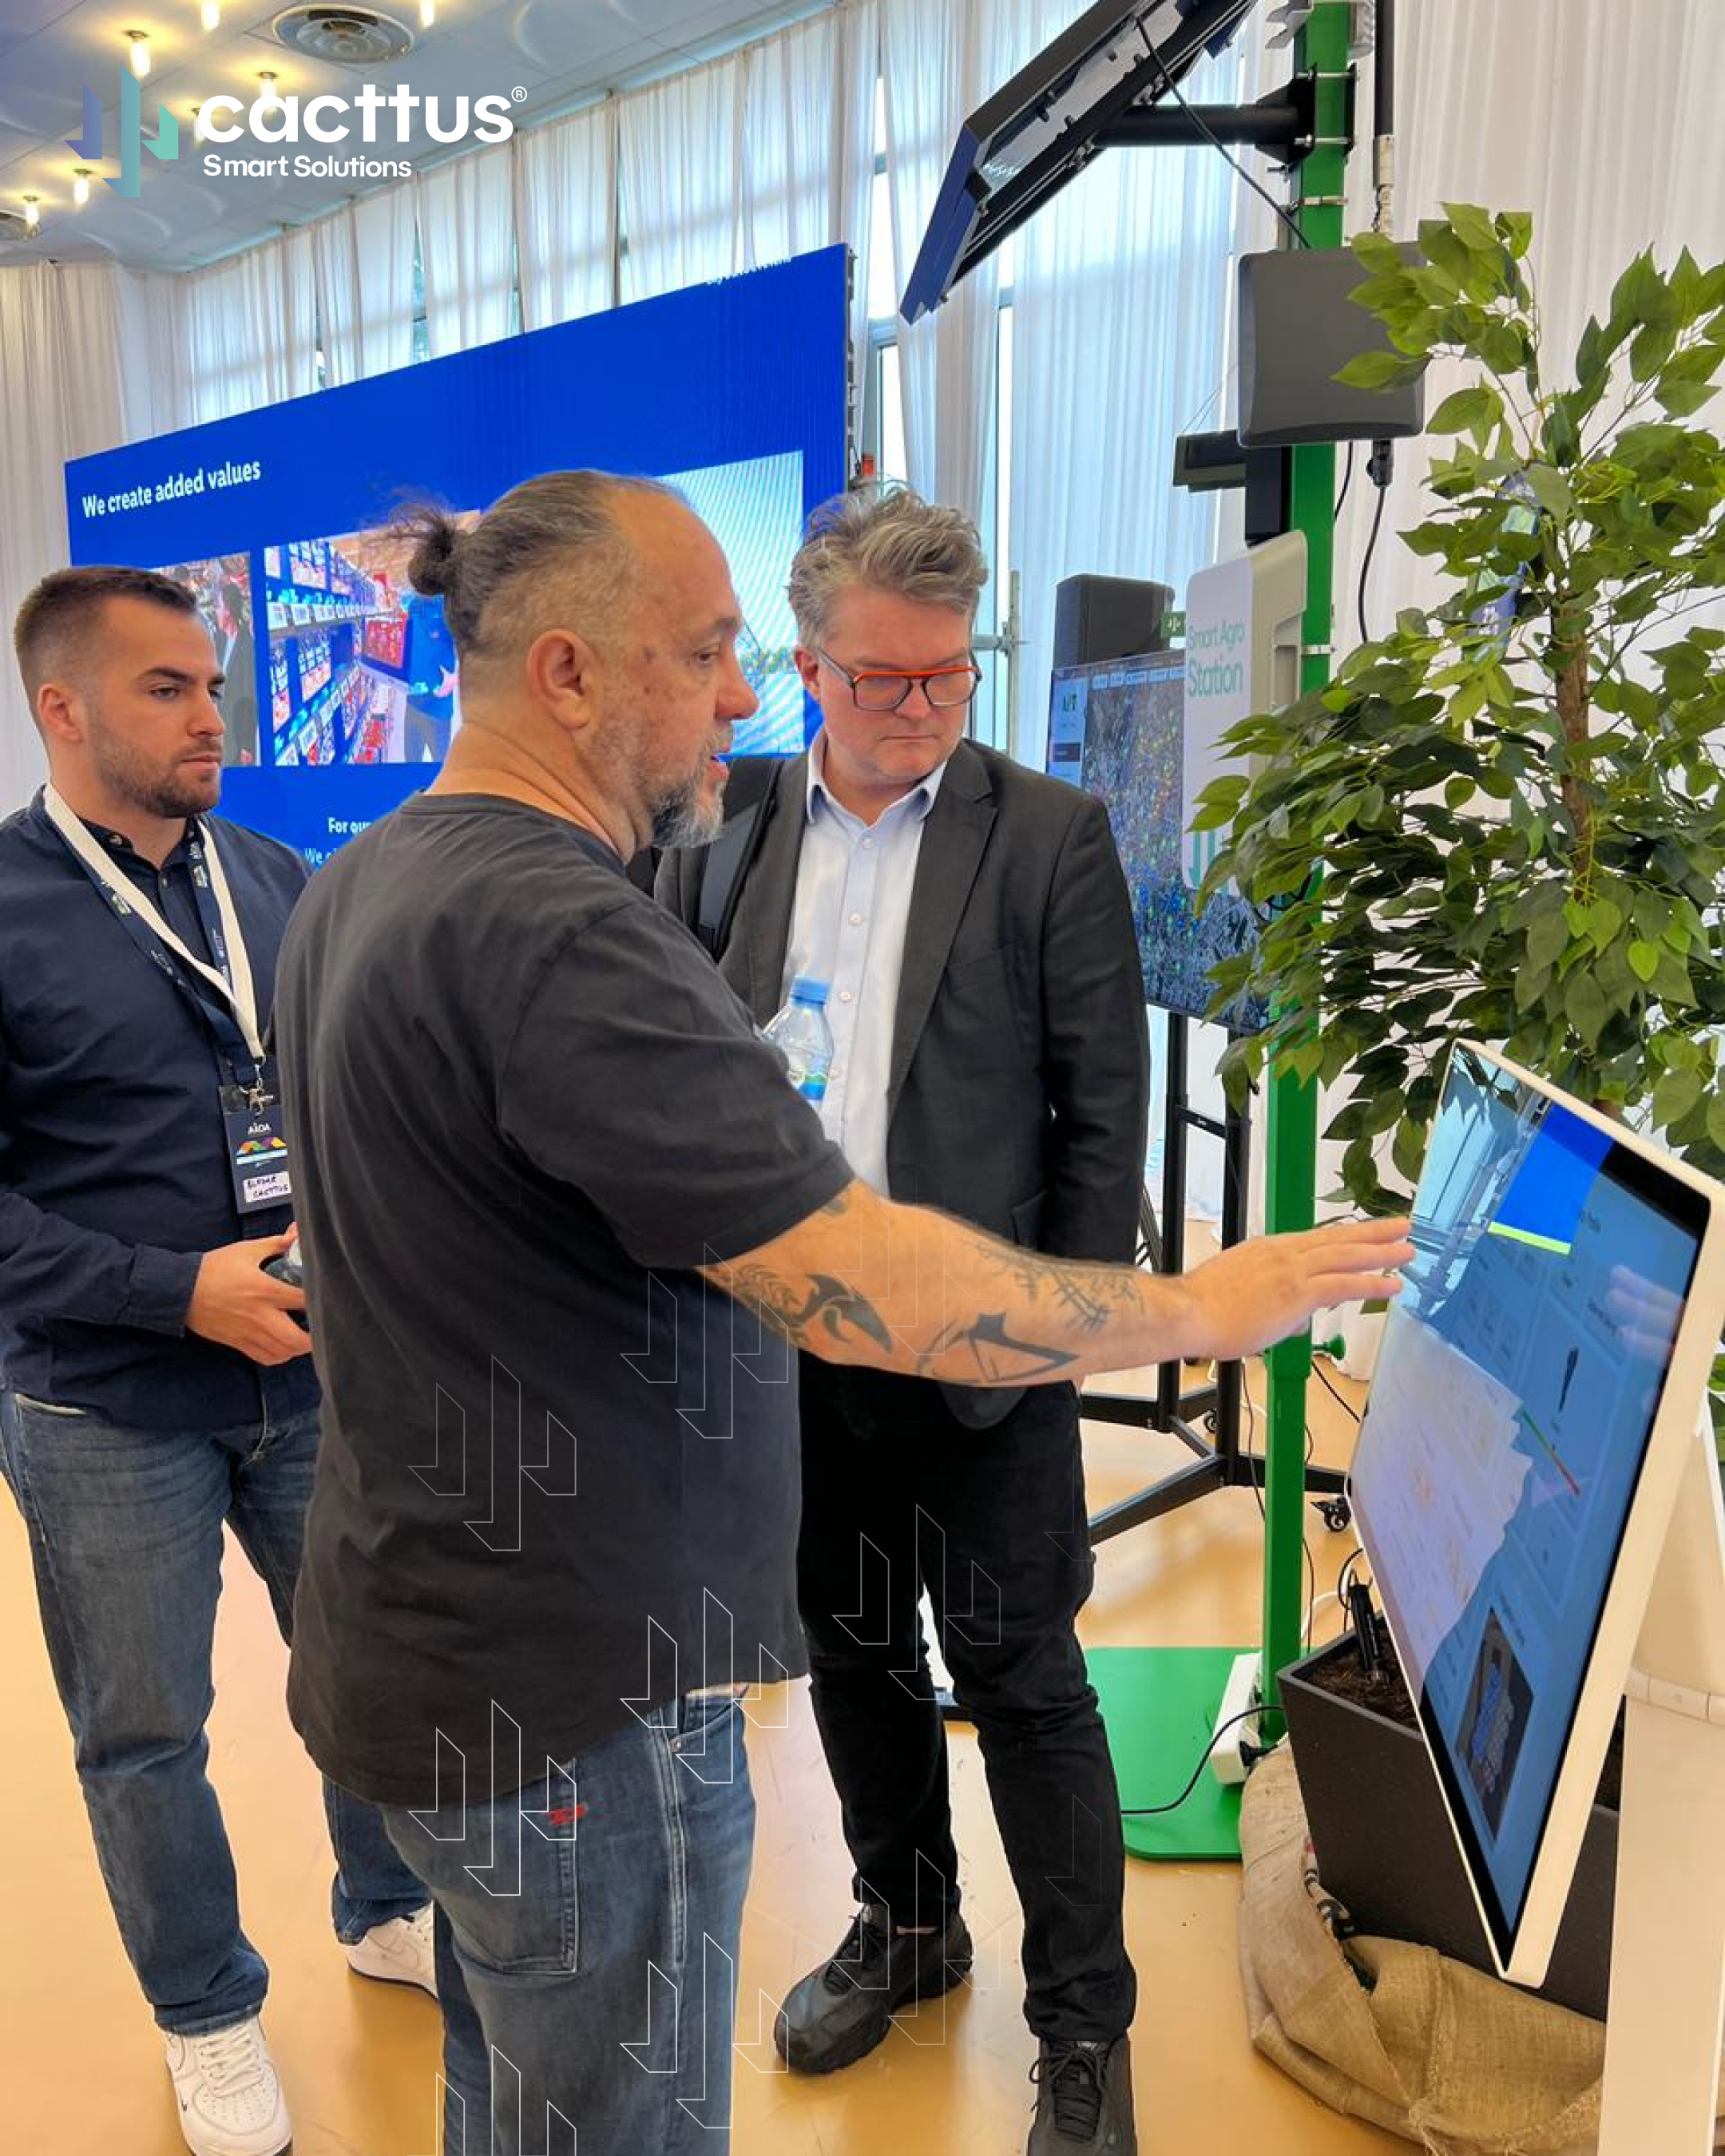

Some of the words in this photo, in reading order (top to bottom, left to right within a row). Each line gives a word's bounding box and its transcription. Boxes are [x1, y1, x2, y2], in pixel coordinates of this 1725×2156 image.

[82, 493, 105, 517] We
[107, 485, 152, 513] create
[155, 467, 205, 502] added
[207, 461, 261, 489] values
[1188, 657, 1243, 697] Station
[327, 817, 347, 834] For
